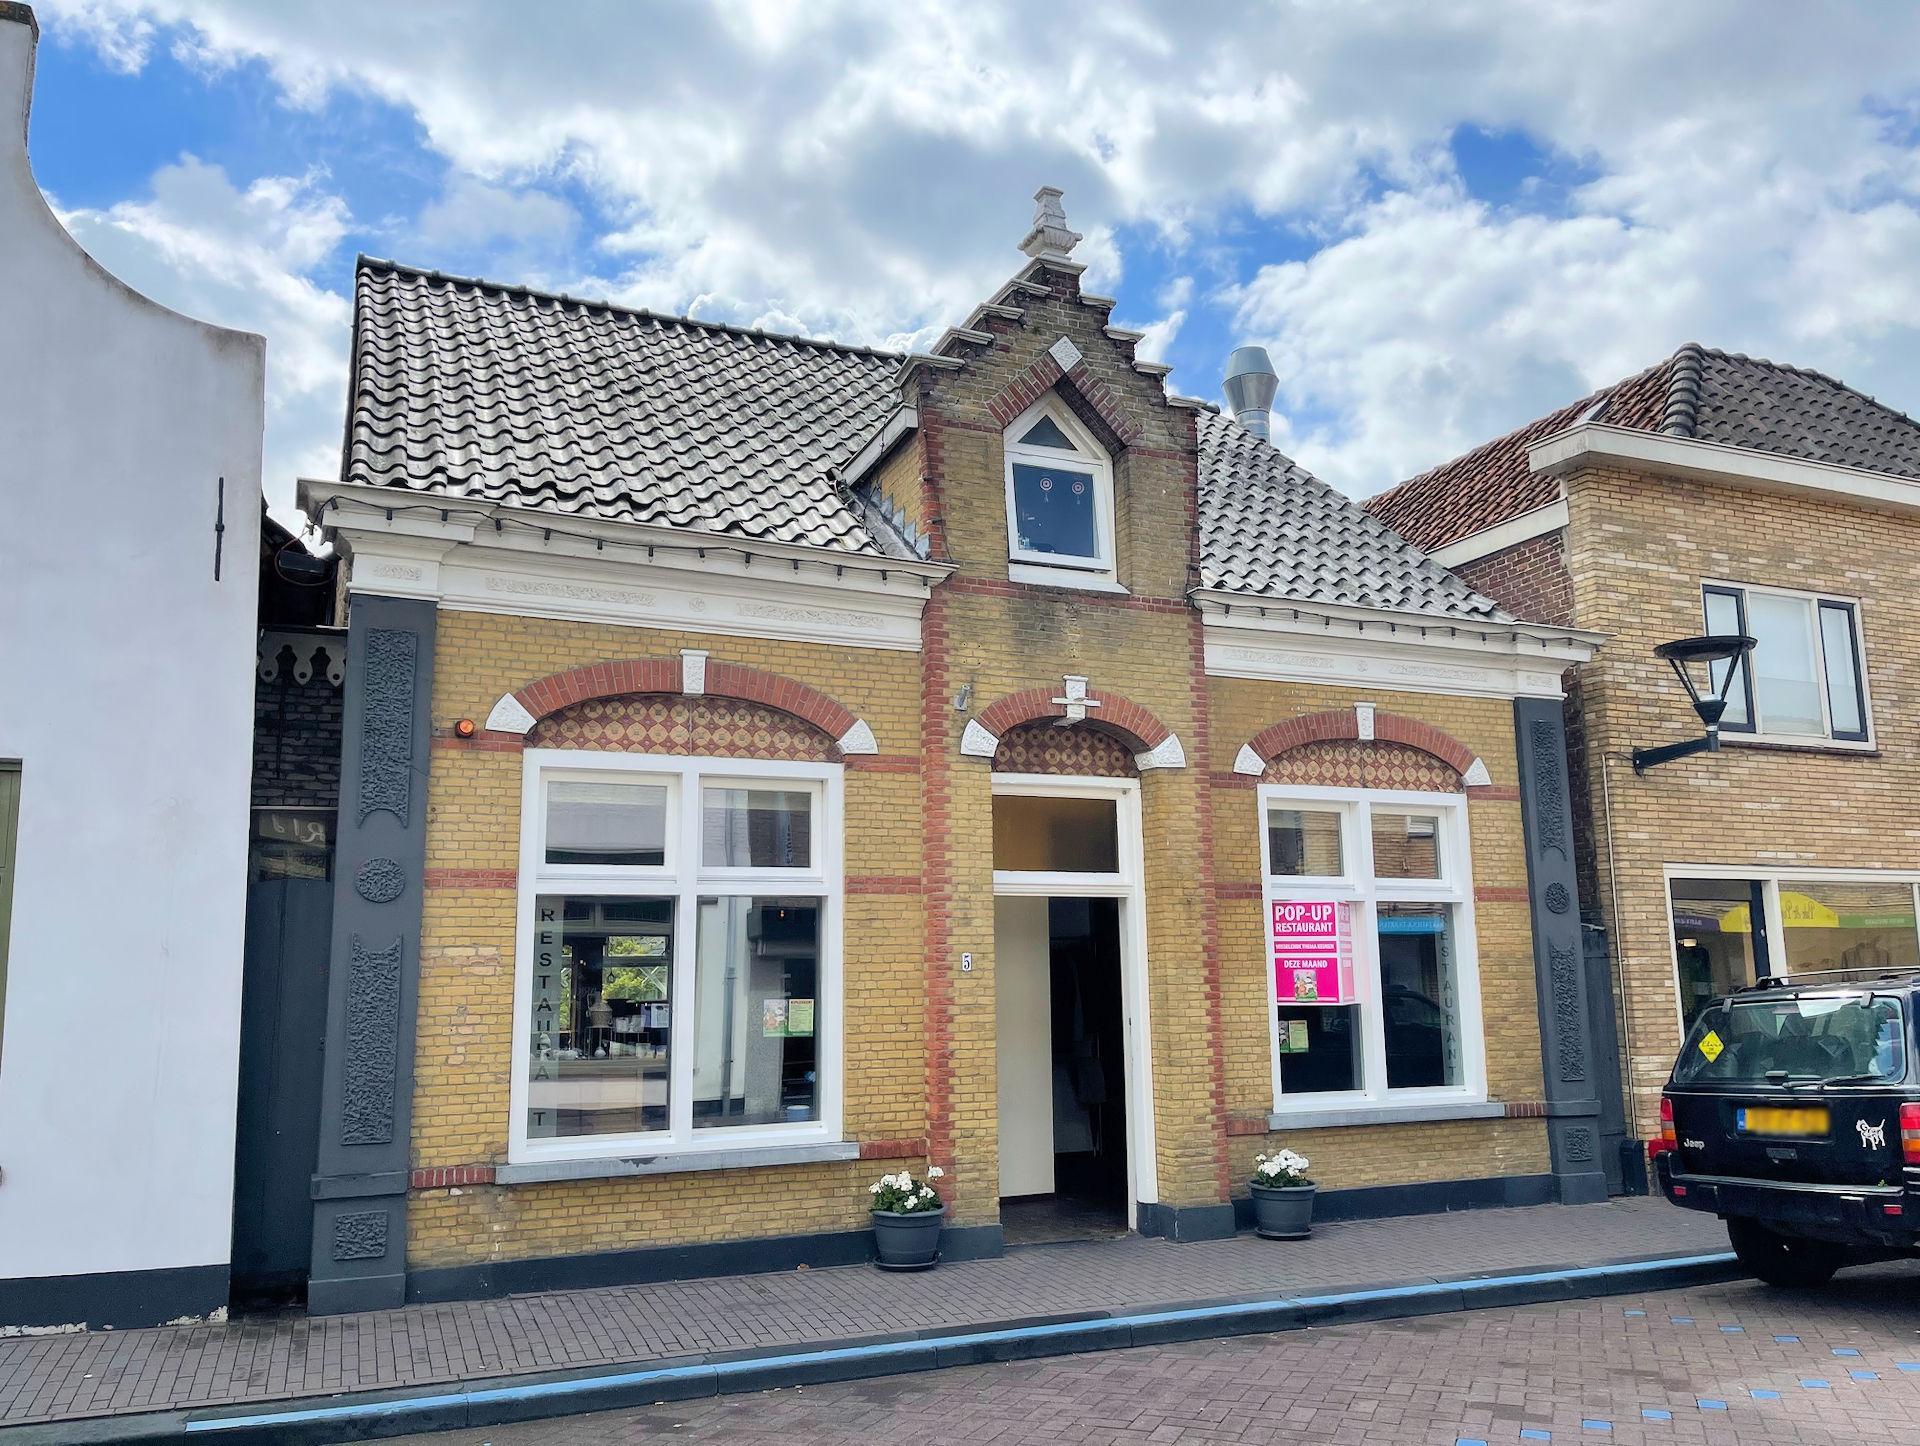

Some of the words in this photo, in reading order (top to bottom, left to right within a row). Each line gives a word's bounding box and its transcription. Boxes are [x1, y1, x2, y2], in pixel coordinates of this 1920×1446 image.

[1274, 905, 1333, 922] POP-UP
[1275, 922, 1333, 933] RESTAURANT
[963, 954, 971, 971] 5
[1283, 960, 1301, 969] DEZE
[1301, 960, 1328, 969] MAAND
[1683, 1138, 1705, 1150] Jeep
